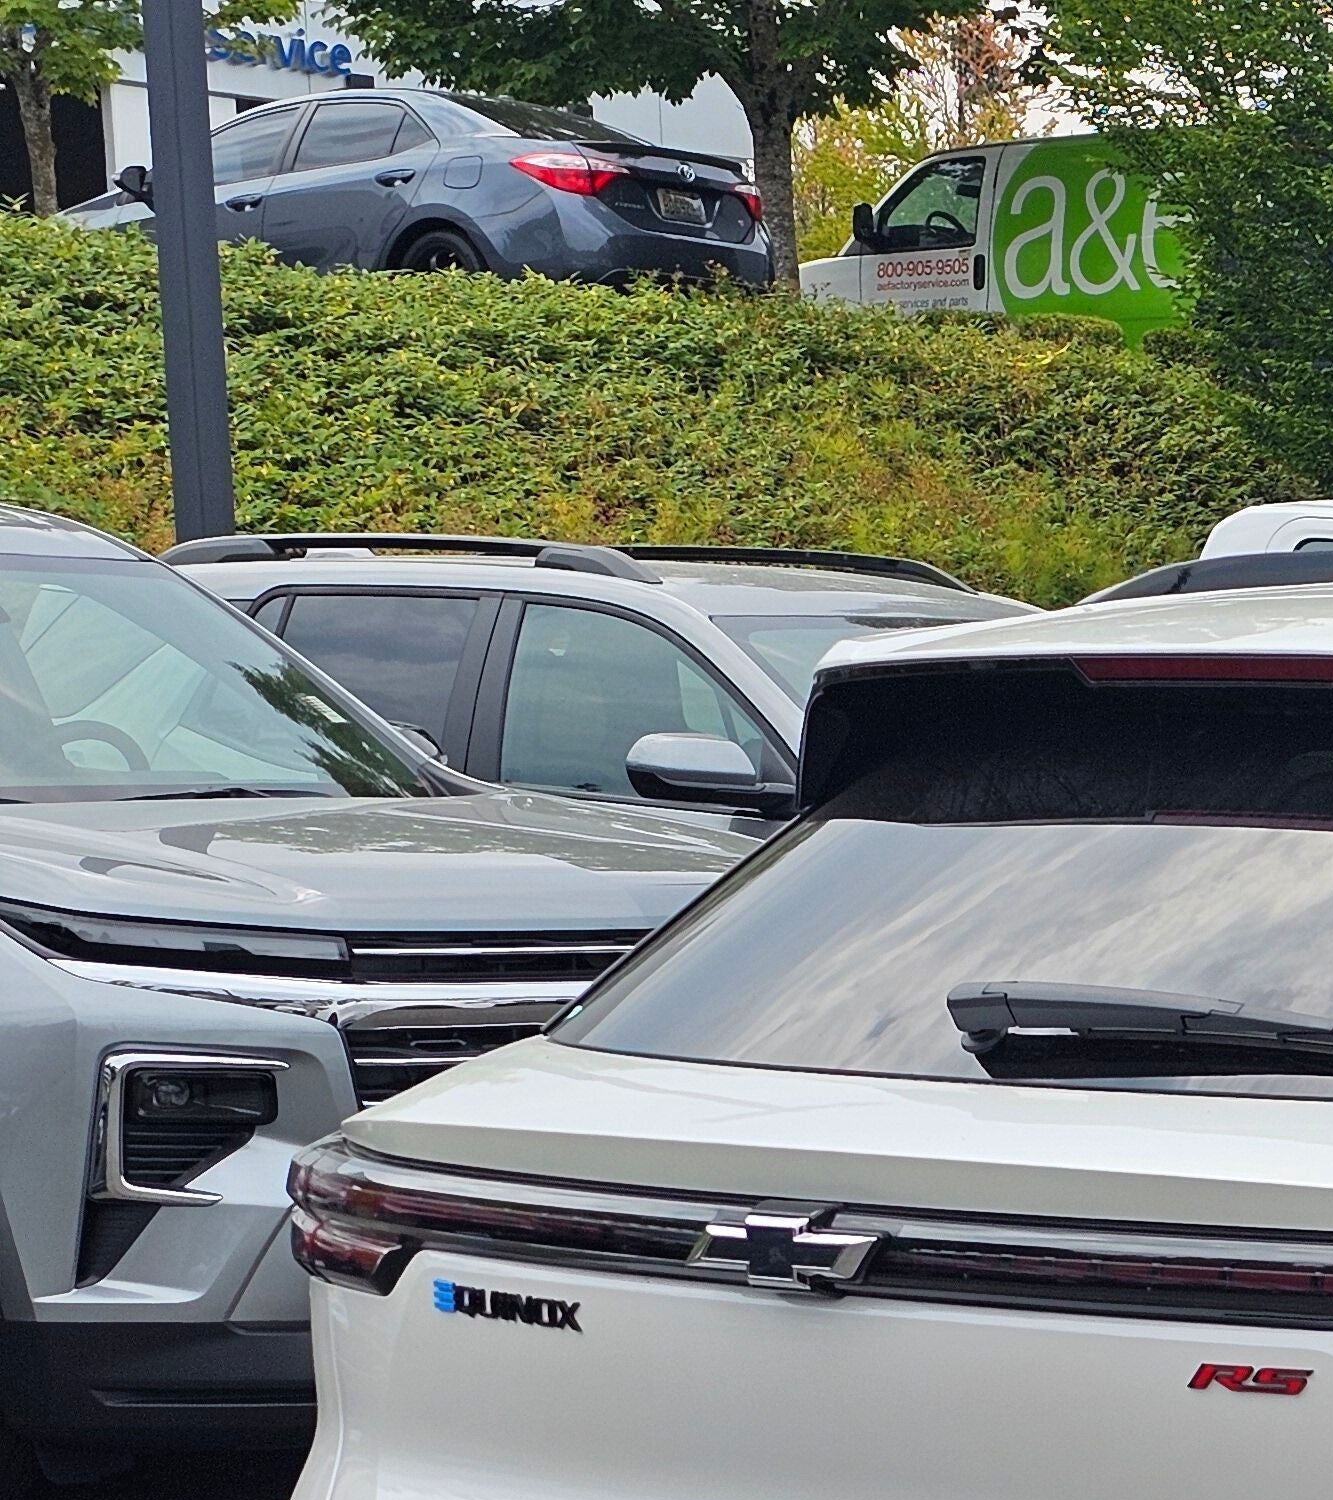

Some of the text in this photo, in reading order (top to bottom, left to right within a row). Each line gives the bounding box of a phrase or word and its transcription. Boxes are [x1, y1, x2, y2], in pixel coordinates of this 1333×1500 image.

[876, 257, 970, 279] 800-905-9505
[931, 296, 947, 308] and
[432, 1278, 584, 1333] EQUINOX
[1186, 1362, 1315, 1396] RS
